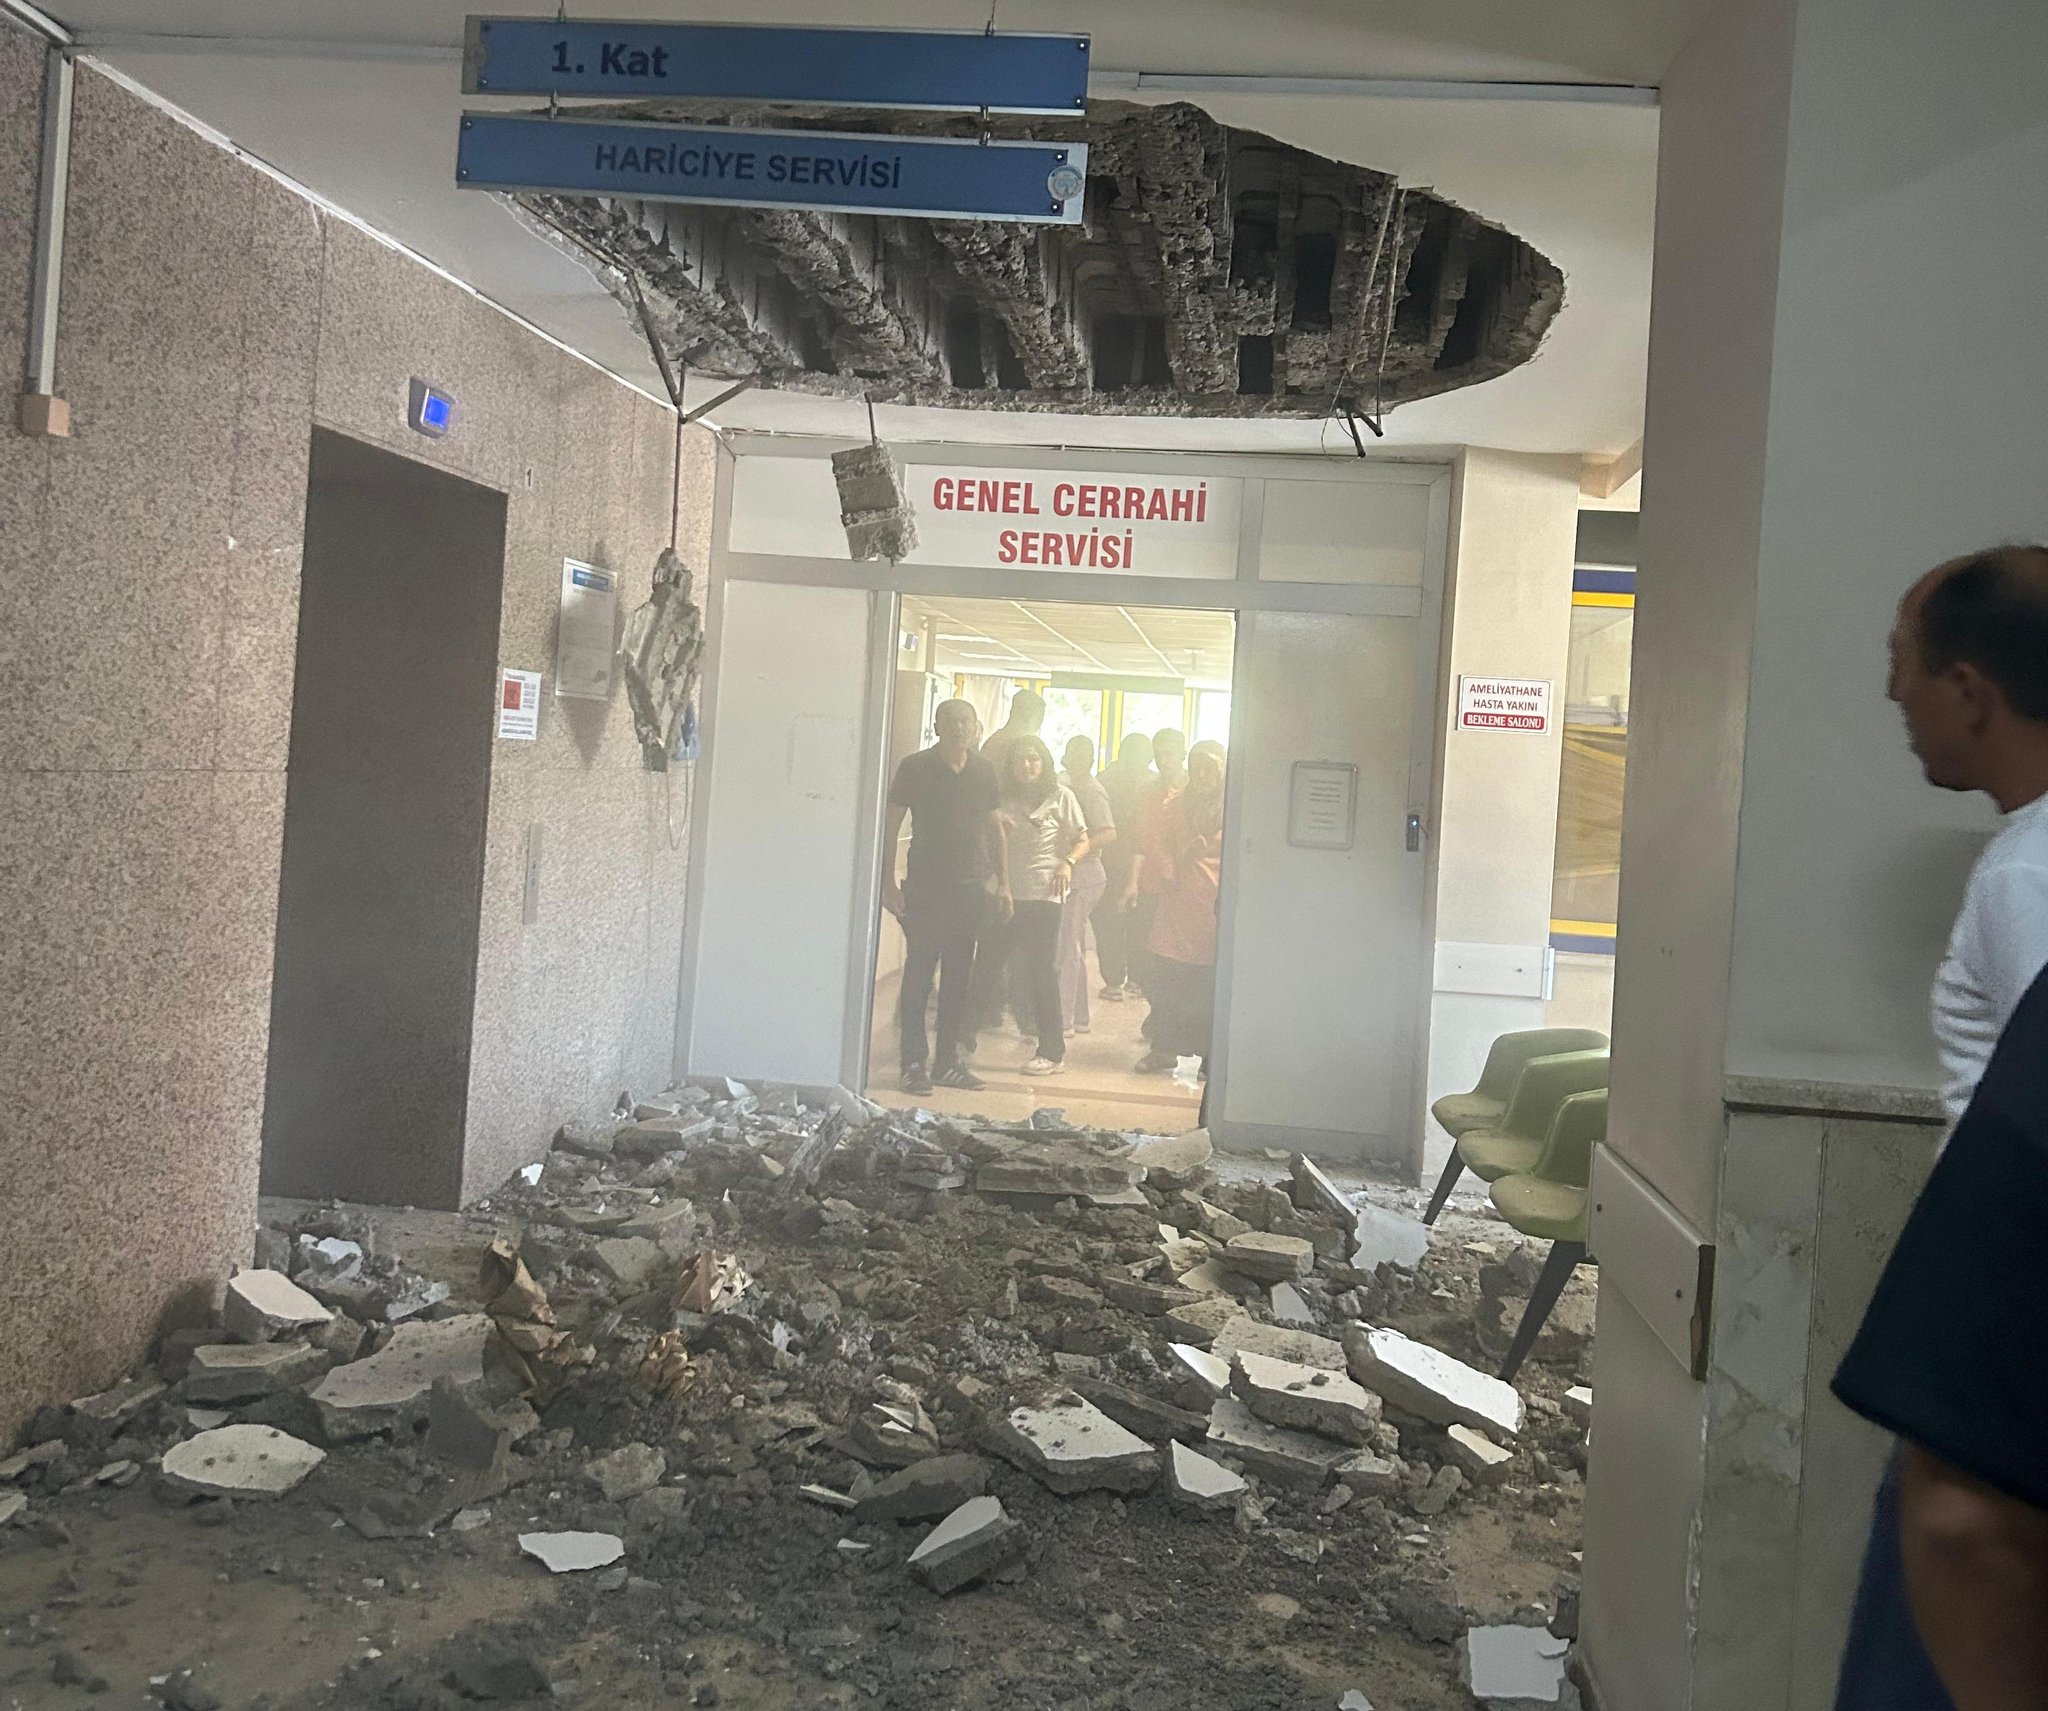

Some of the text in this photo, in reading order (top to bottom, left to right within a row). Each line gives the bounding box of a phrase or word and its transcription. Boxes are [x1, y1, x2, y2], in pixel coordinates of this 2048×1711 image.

[551, 41, 669, 78] 1. Kat
[595, 143, 901, 189] HARİCİYE SERVİSİ
[933, 477, 1207, 522] GENEL CERRAHİ
[998, 527, 1133, 569] SERVİSİ
[1469, 683, 1543, 697] AMELİYATHANE
[1473, 699, 1538, 712] HASTA YAKINI
[1466, 714, 1542, 729] BEKLEME SALONU
